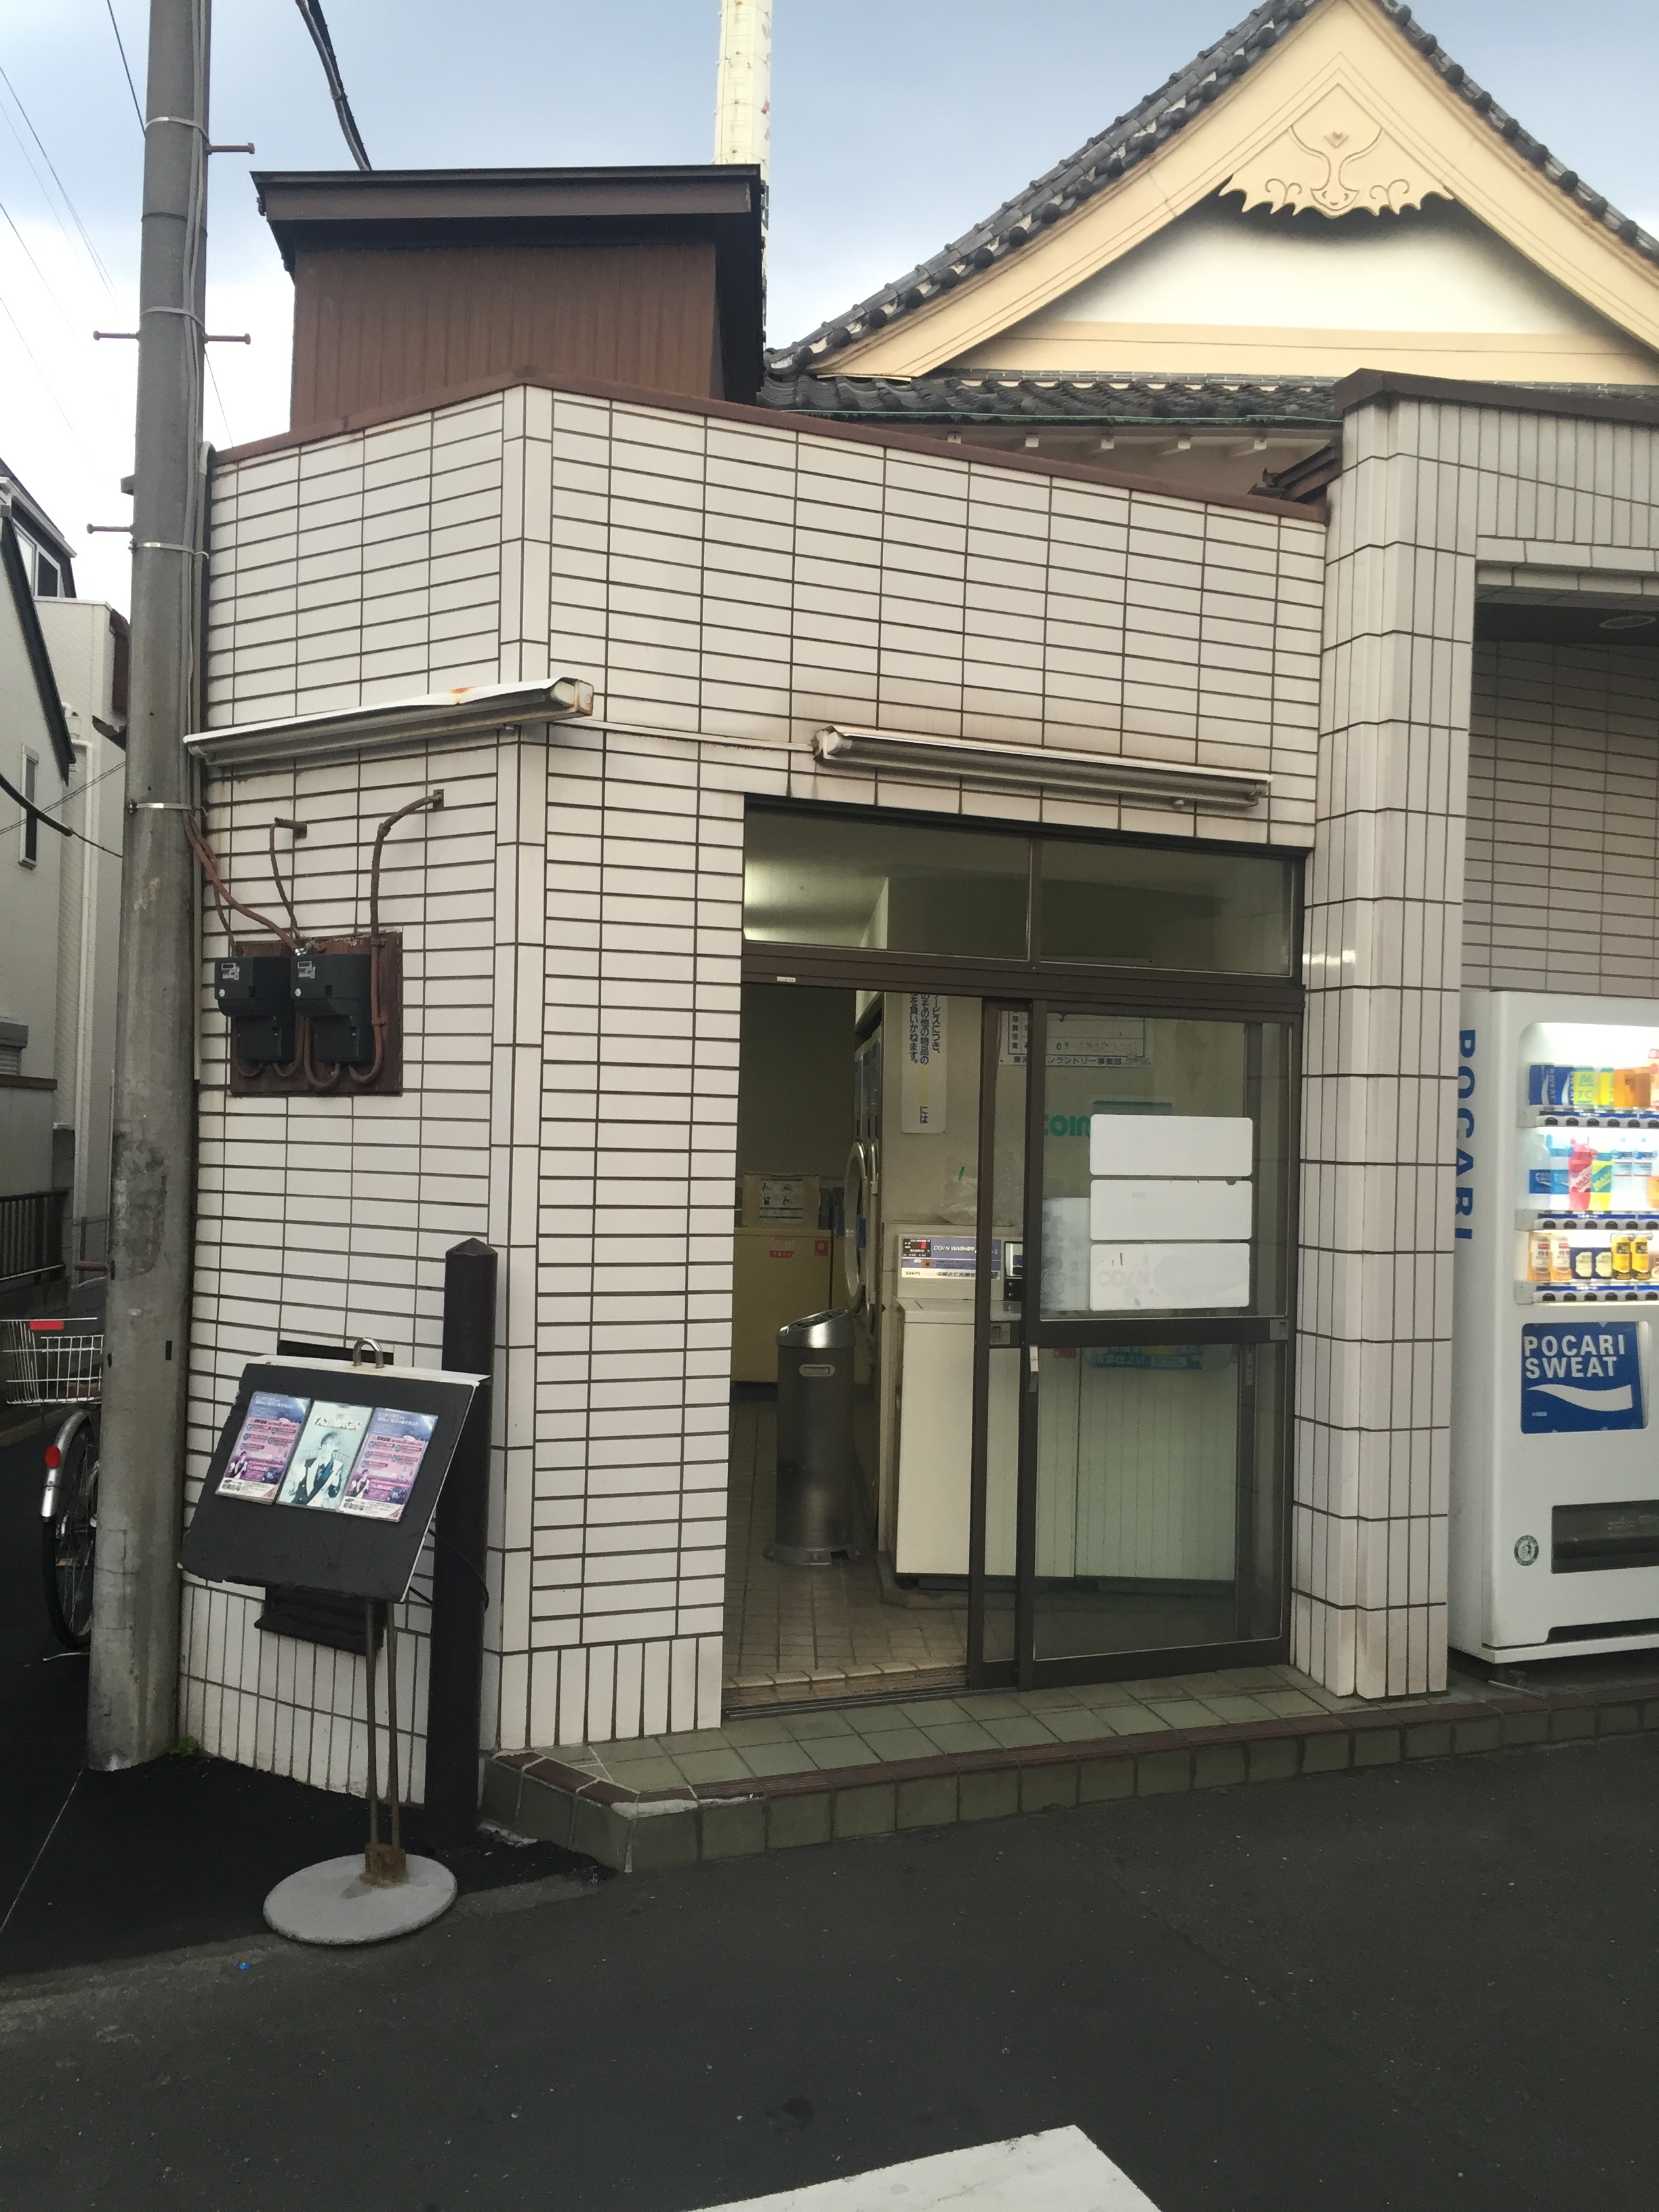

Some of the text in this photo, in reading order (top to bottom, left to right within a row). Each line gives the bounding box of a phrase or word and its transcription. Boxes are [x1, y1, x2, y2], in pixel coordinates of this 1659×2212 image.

[1455, 1029, 1476, 1240] POCARI
[1523, 1334, 1625, 1357] POCARI
[1525, 1356, 1618, 1379] SWEAT
